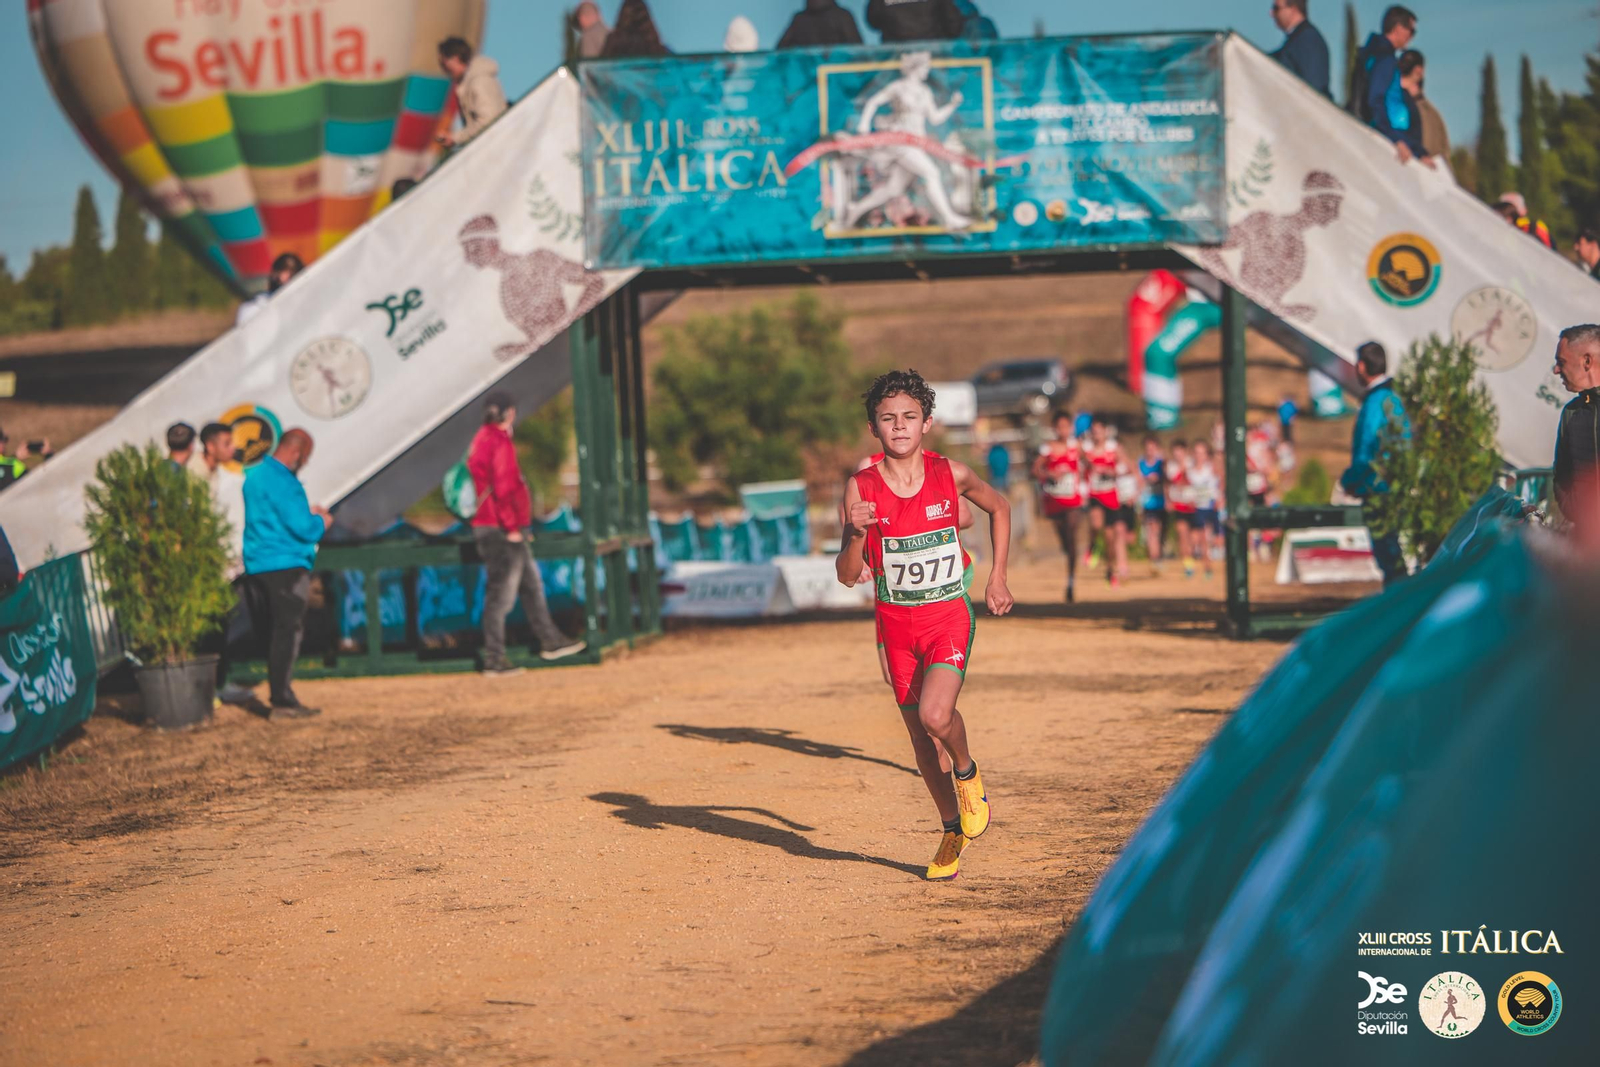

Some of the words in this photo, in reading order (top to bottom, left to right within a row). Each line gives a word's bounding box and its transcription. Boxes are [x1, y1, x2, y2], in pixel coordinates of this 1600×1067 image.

[144, 9, 387, 102] Sevilla.
[903, 535, 938, 548] ITÁLICA
[891, 554, 956, 585] 7977
